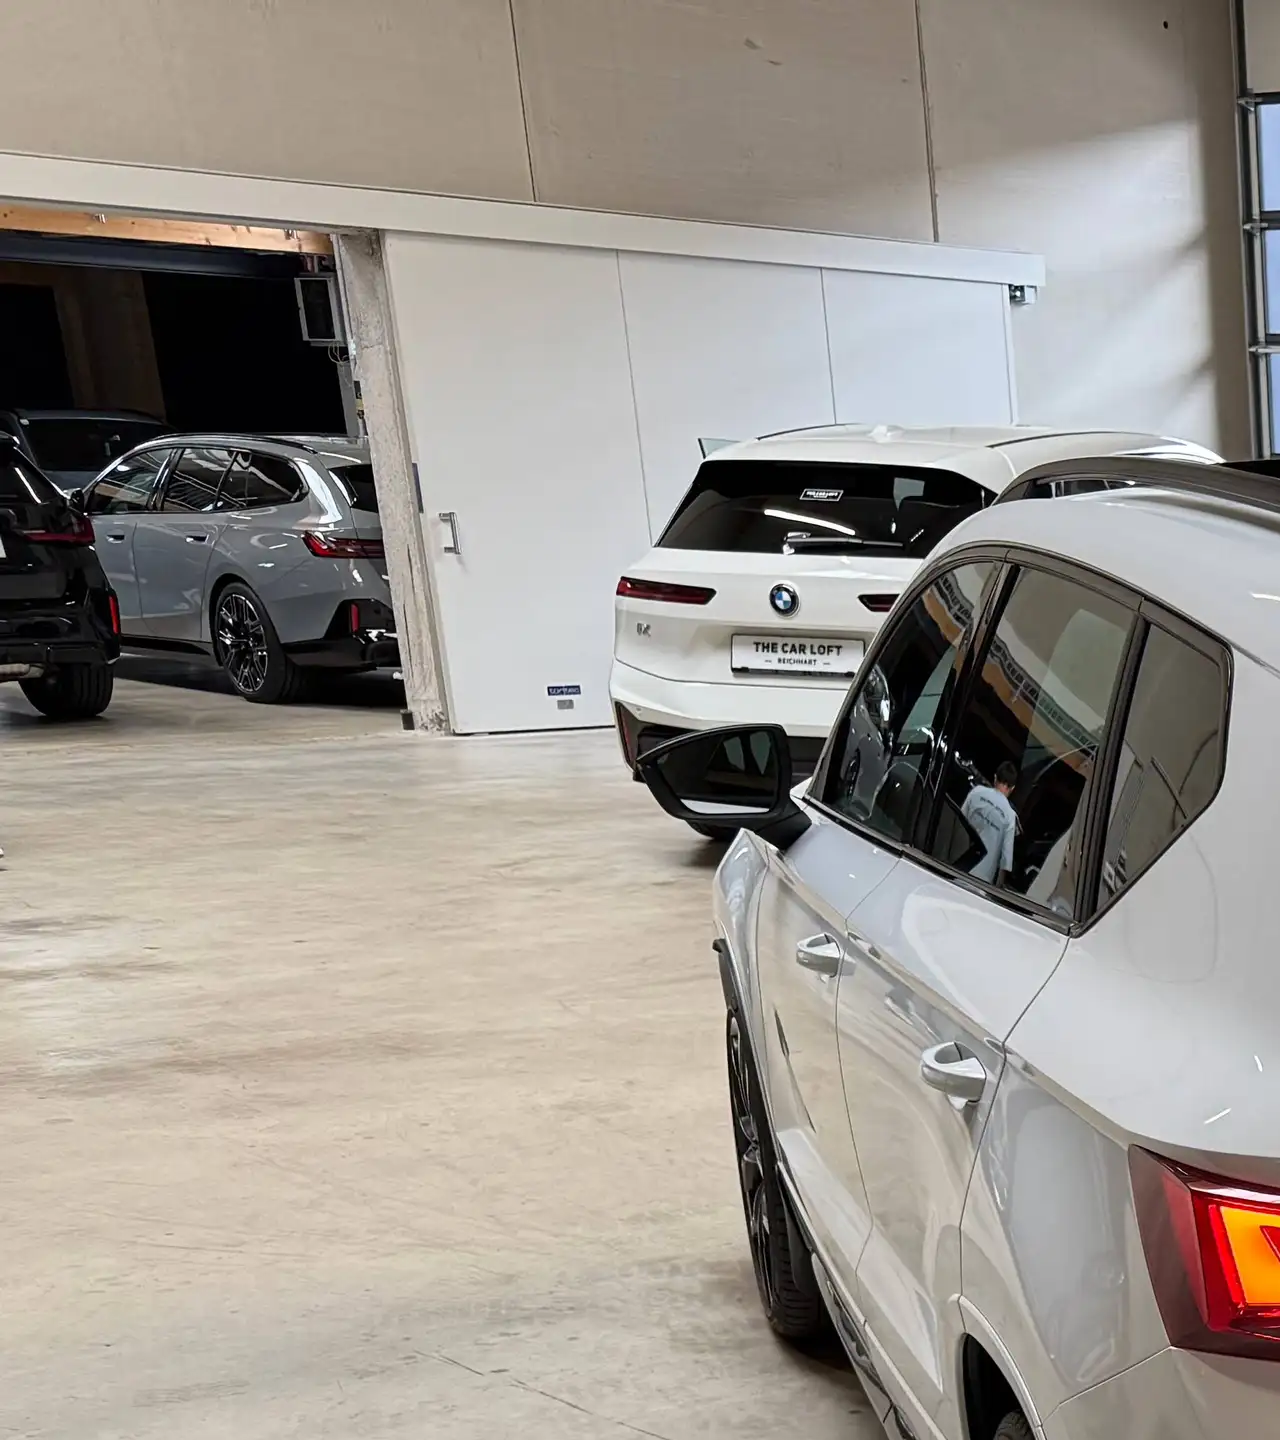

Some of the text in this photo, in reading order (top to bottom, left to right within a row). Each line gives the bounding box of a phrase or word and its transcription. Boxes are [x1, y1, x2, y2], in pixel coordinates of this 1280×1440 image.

[753, 641, 843, 657] THE CAR LOFT
